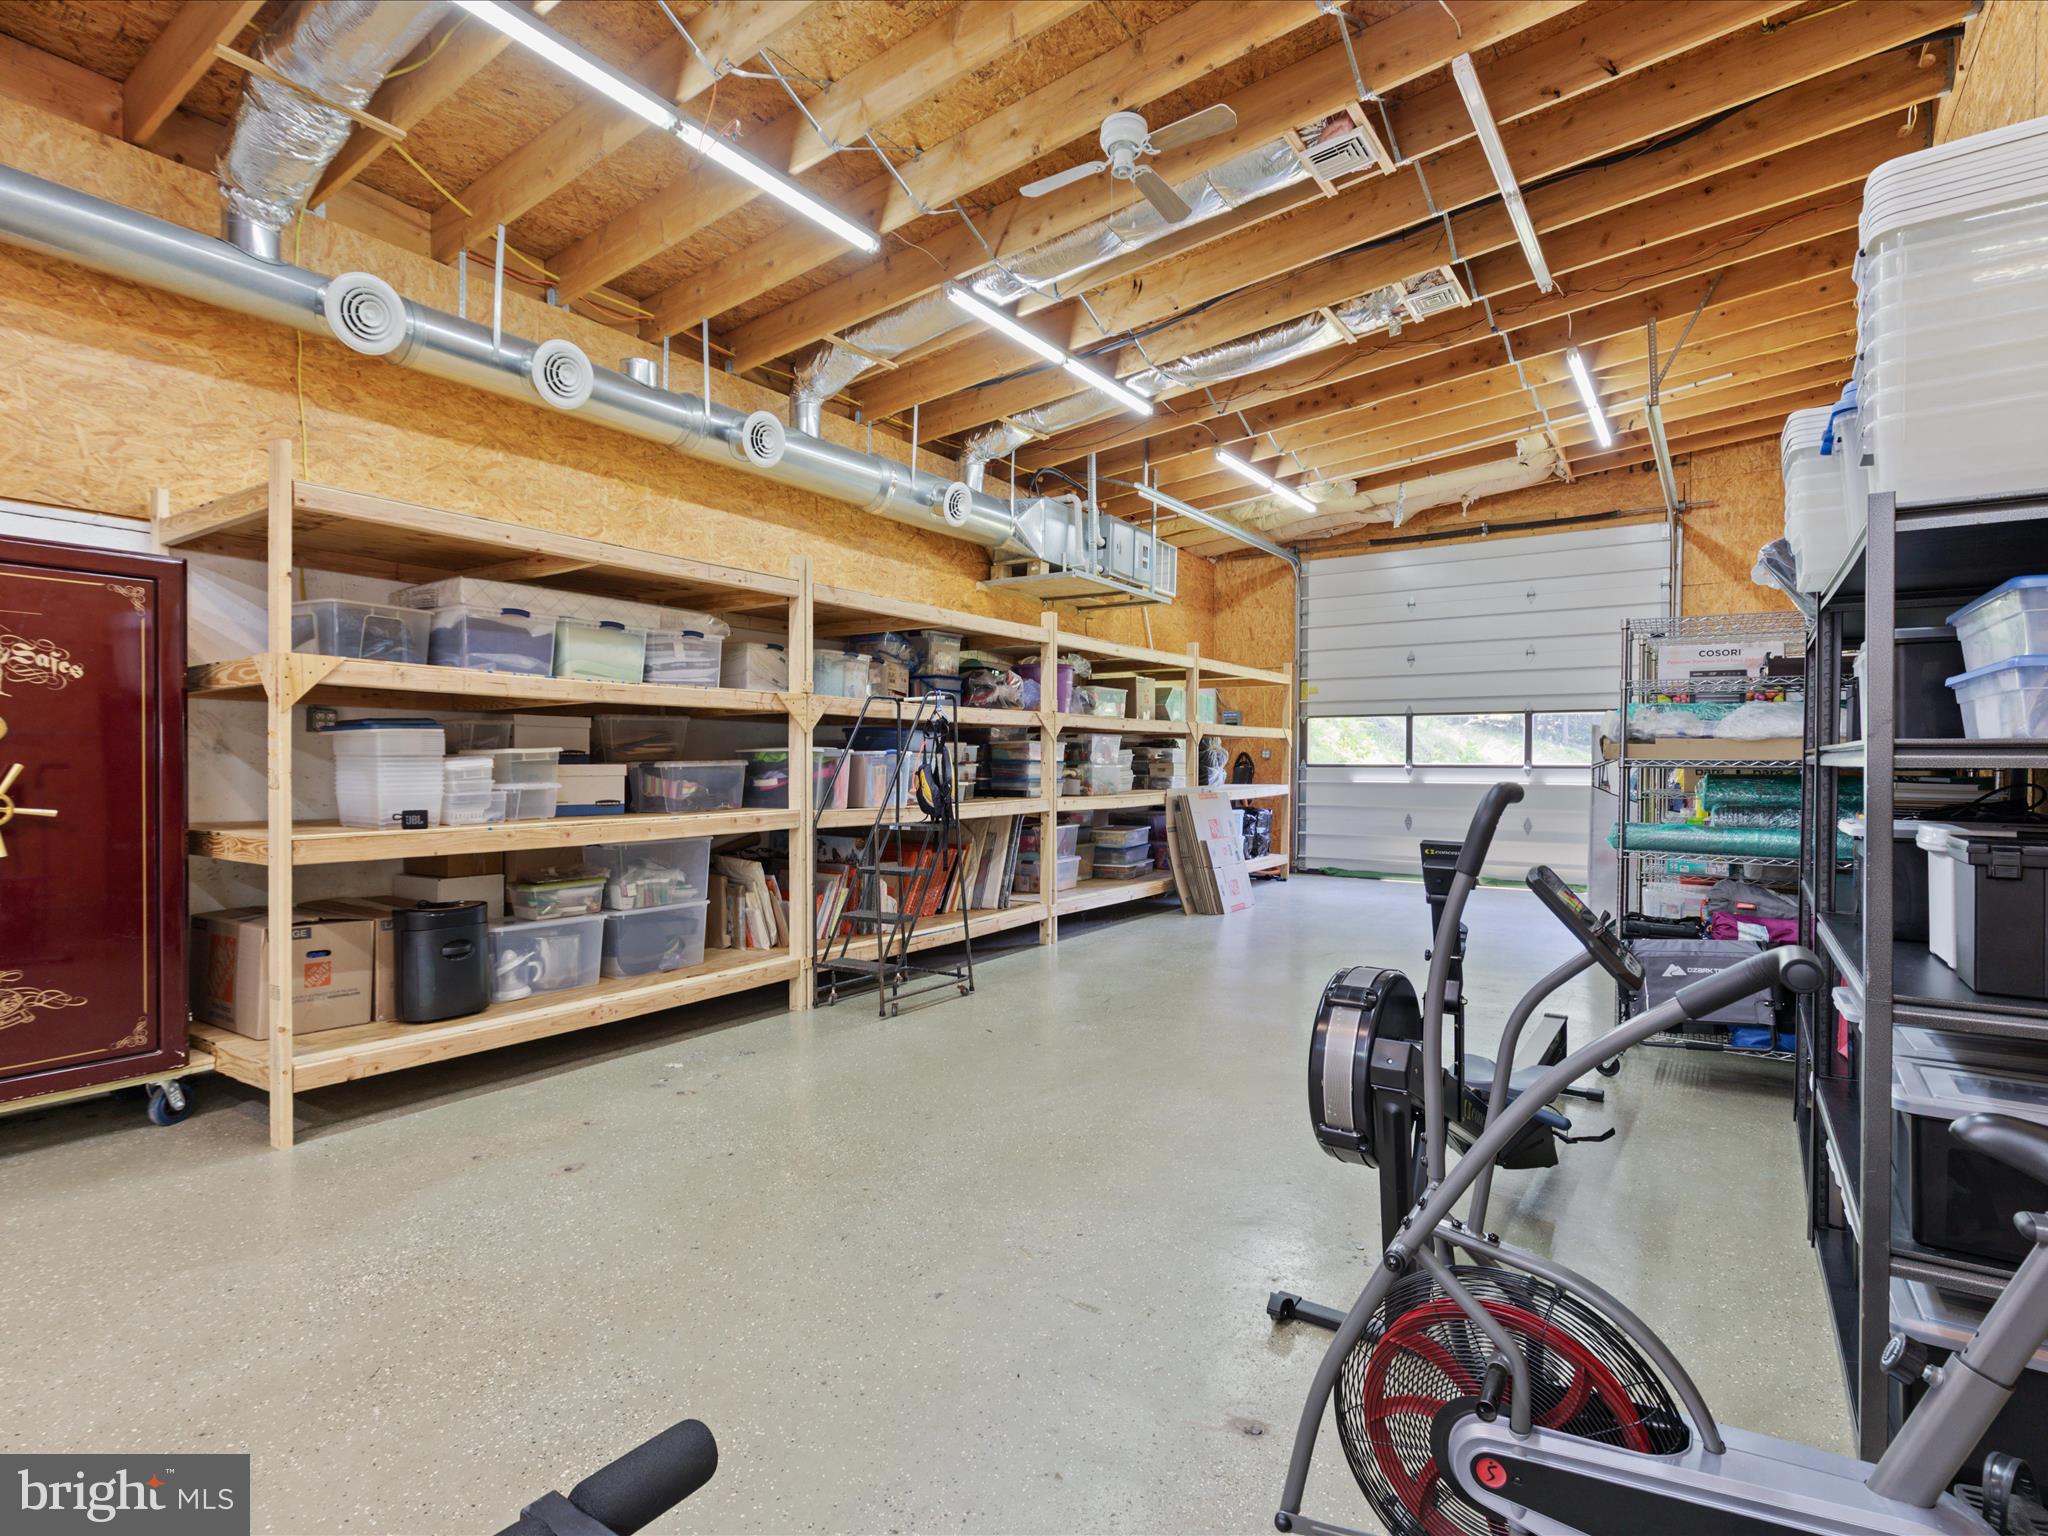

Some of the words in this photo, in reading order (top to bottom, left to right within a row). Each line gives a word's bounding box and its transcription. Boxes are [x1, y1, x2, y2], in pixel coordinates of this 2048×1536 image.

[1698, 648, 1742, 658] COSORI
[8, 642, 84, 679] Safes
[405, 814, 424, 825] JBL
